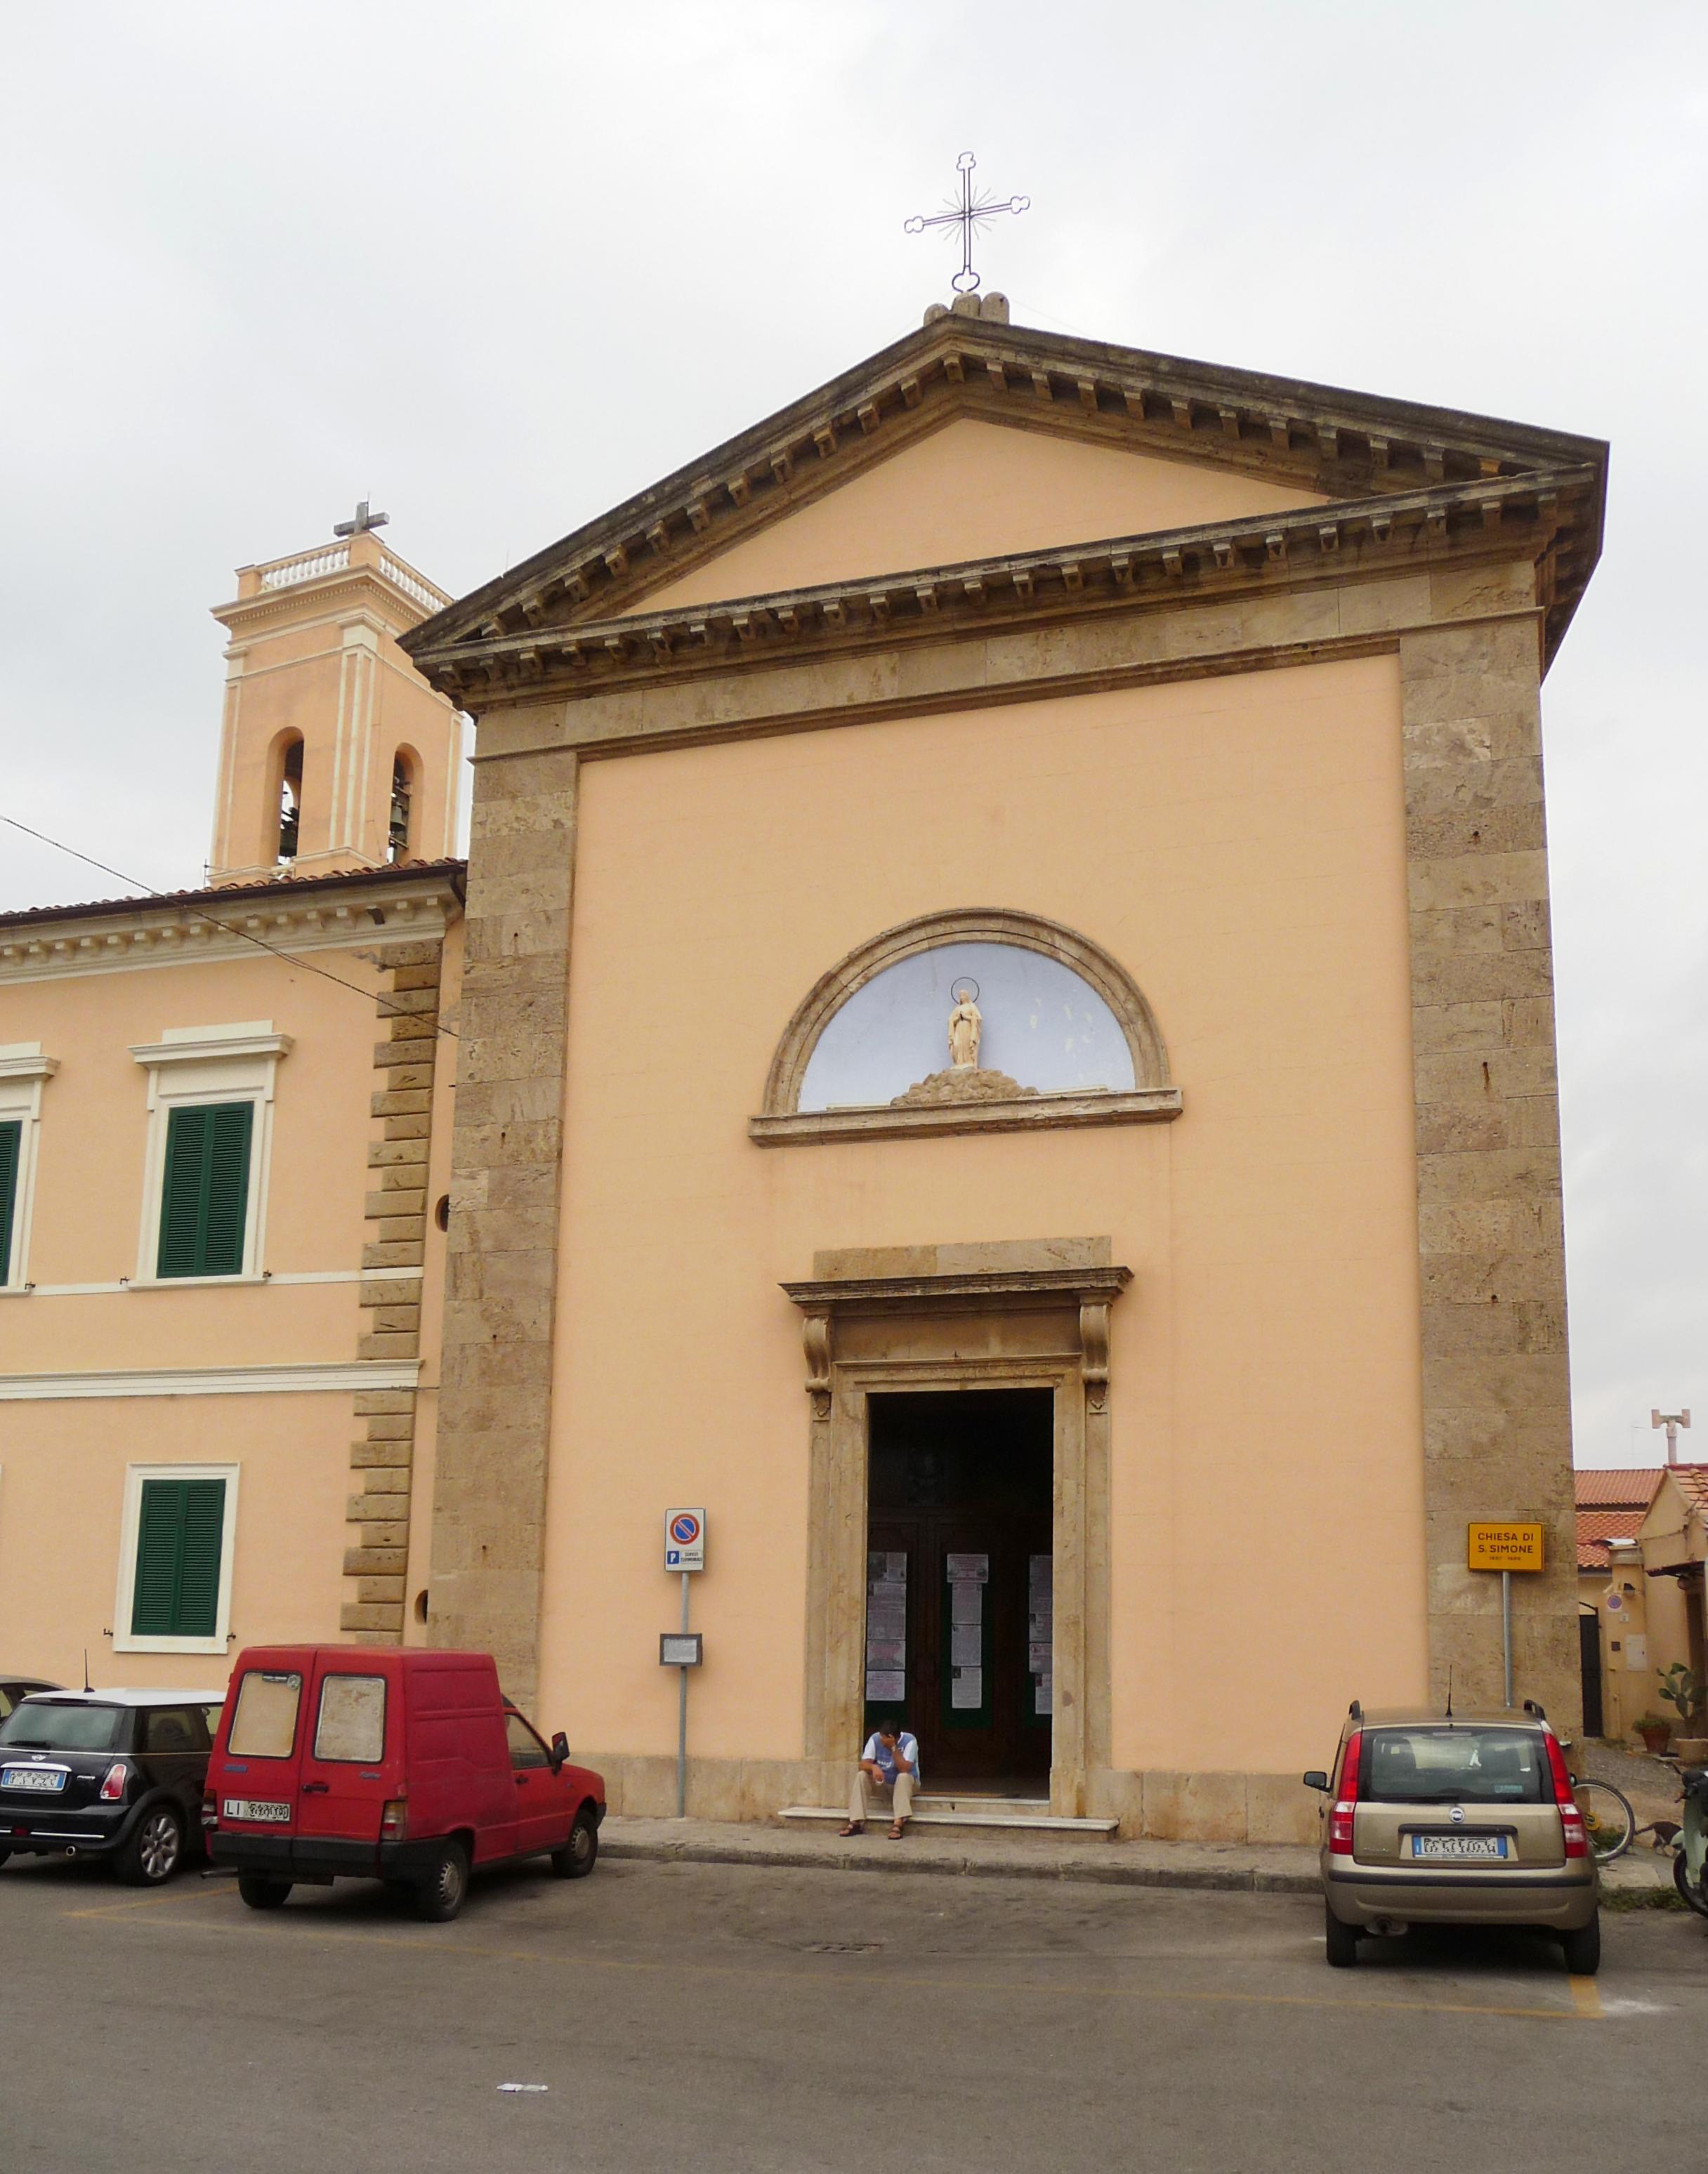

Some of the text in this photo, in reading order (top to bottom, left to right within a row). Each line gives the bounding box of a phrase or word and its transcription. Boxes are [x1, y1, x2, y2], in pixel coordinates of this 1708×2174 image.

[1478, 1532, 1534, 1541] CHIESA DI
[1490, 1545, 1534, 1553] SIMONE
[670, 1553, 676, 1563] P
